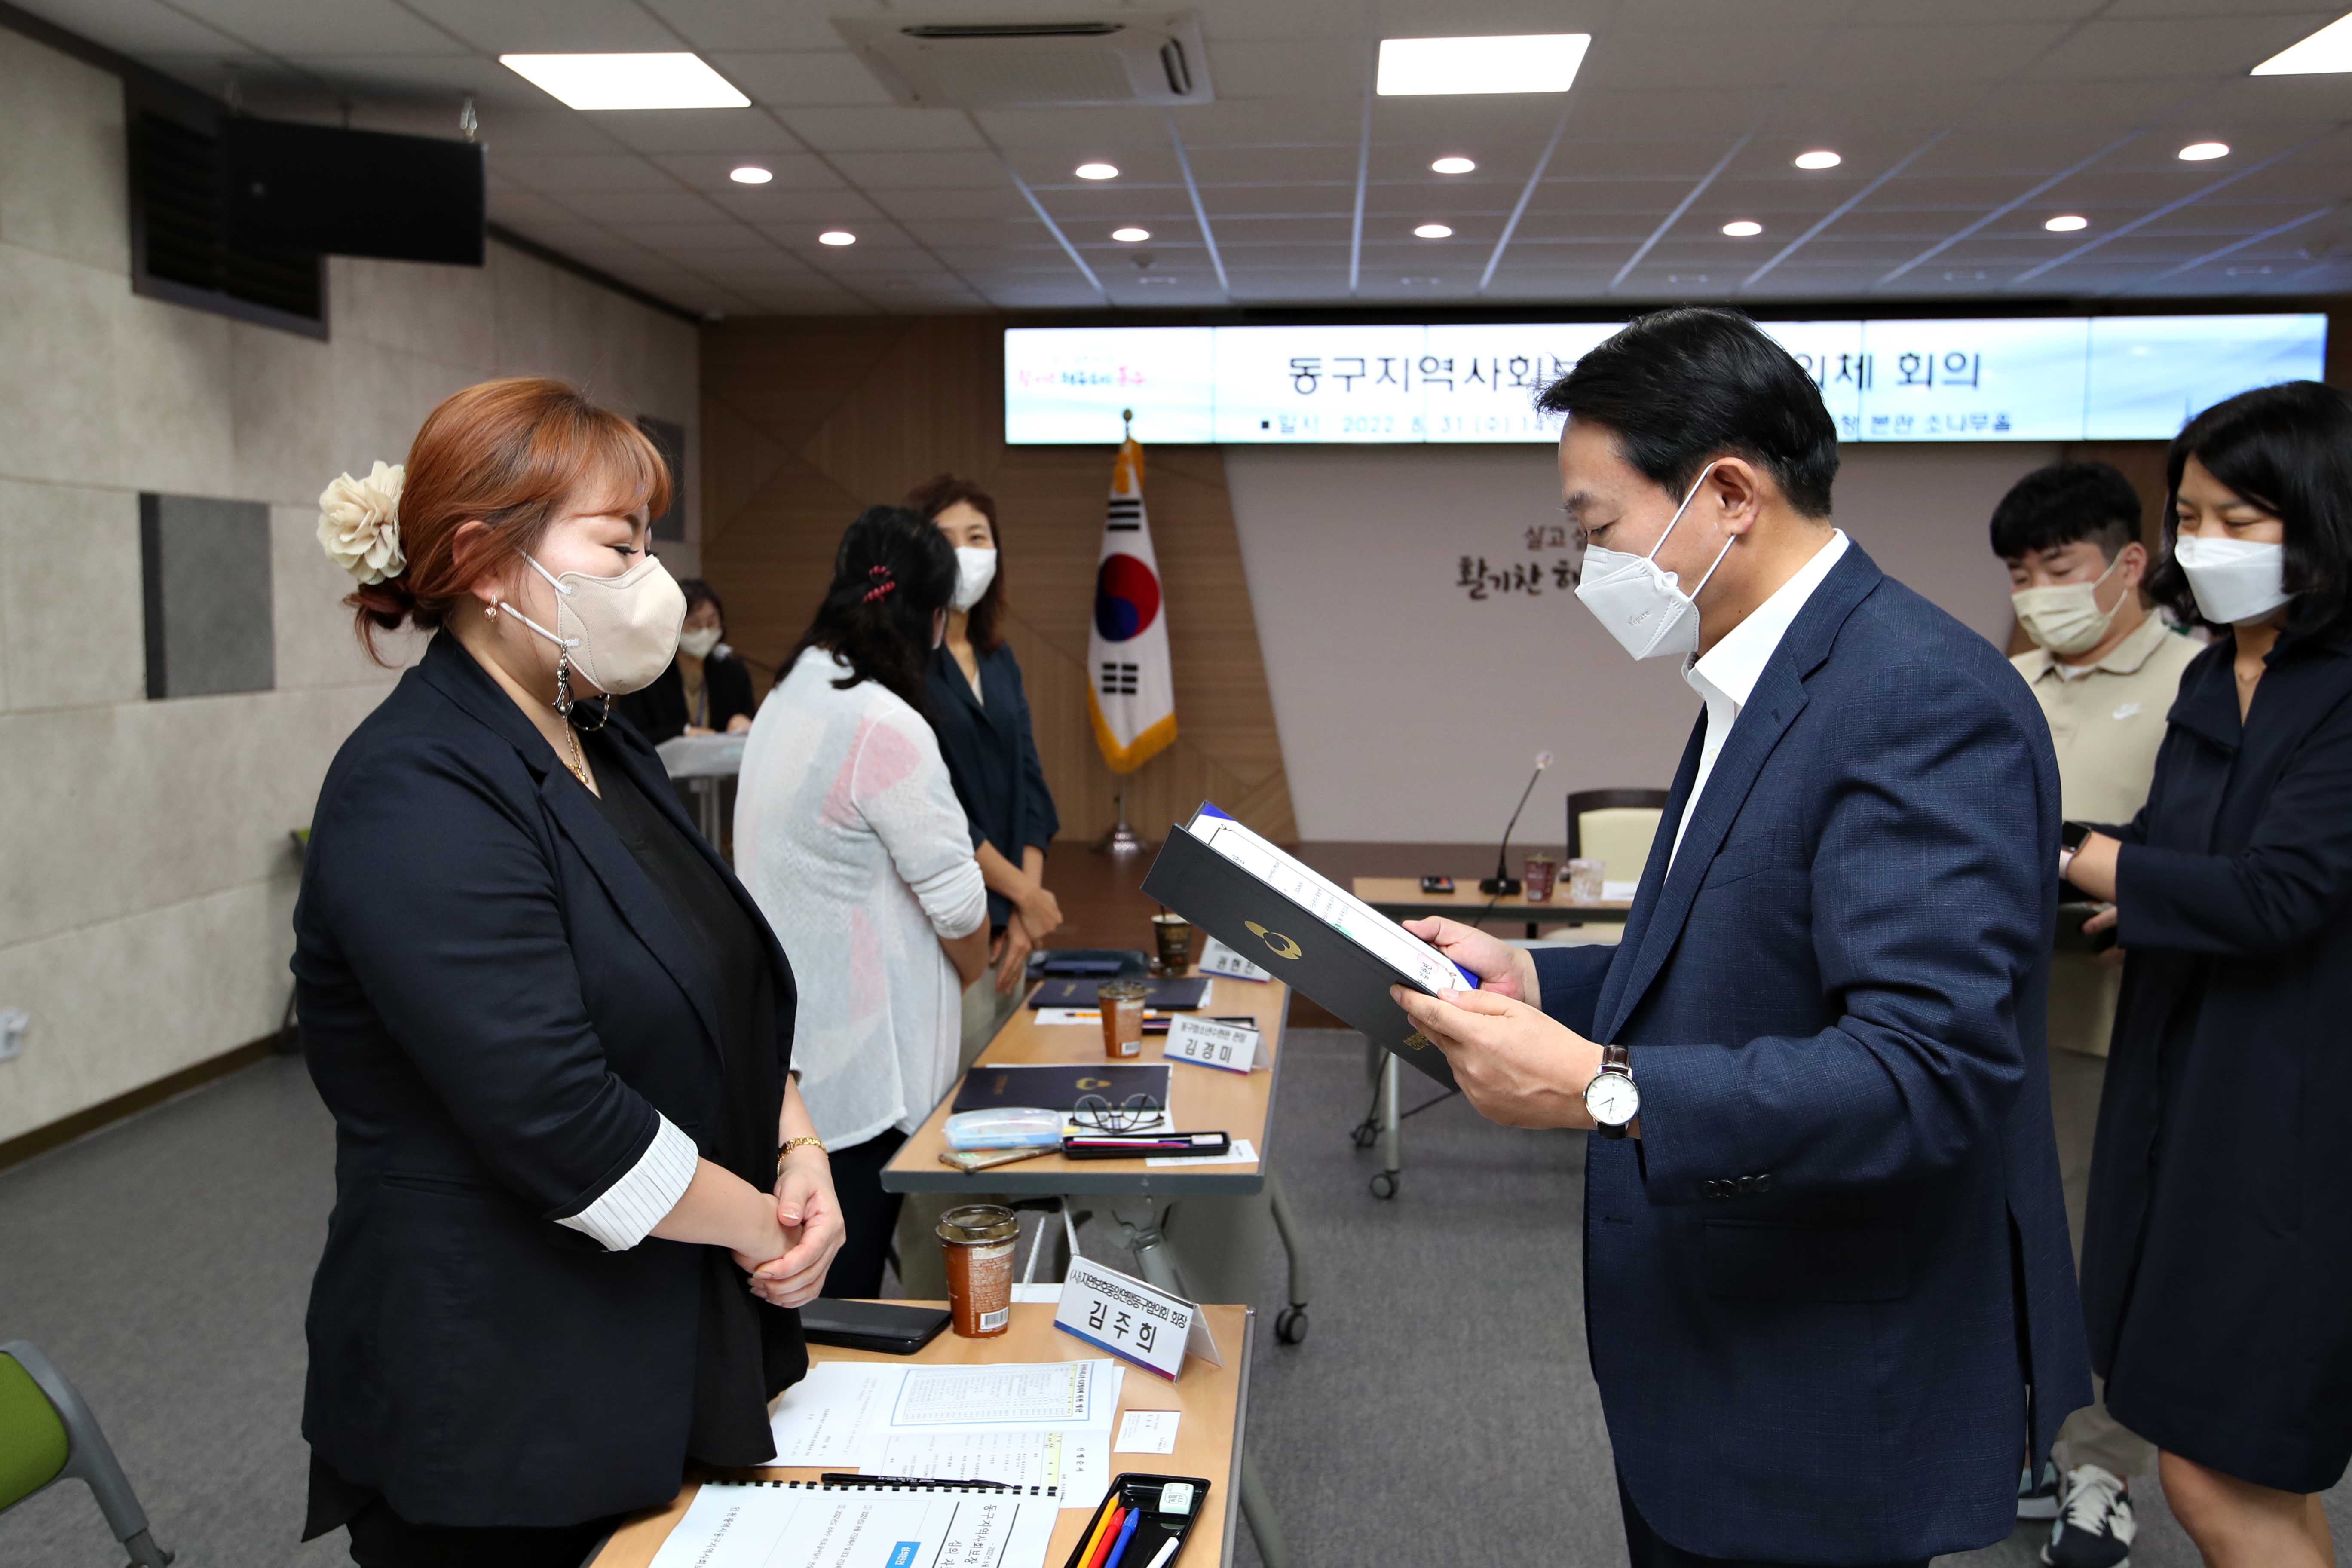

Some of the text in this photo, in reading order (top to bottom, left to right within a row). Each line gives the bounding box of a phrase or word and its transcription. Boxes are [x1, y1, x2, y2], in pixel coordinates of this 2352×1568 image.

[1897, 352, 1980, 389] 회의
[1185, 1038, 1233, 1063] 김경미
[1089, 1300, 1157, 1353] 김주희
[1170, 1311, 1188, 1329] 회장
[962, 1504, 998, 1564] 동구지역사회보장
[894, 1546, 912, 1566] 심의안건
